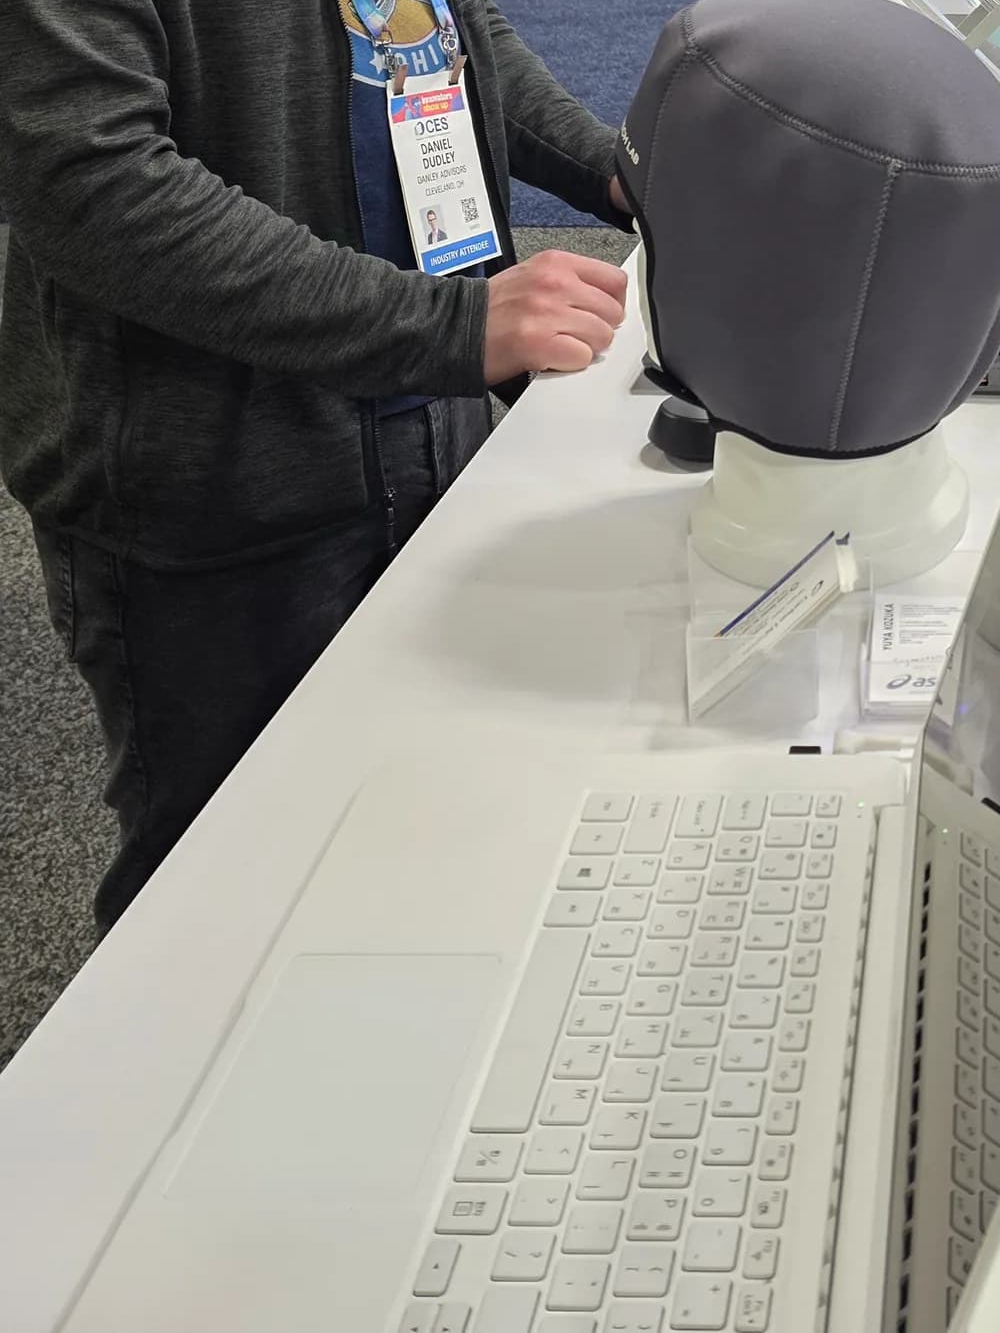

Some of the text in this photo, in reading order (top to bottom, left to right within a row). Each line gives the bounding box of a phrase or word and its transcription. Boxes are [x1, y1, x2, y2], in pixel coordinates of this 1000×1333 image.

[426, 117, 449, 134] CES
[421, 138, 452, 155] DANIEL
[422, 151, 455, 169] DUDLEY
[430, 240, 489, 266] INDUSTRY ATTENDEE
